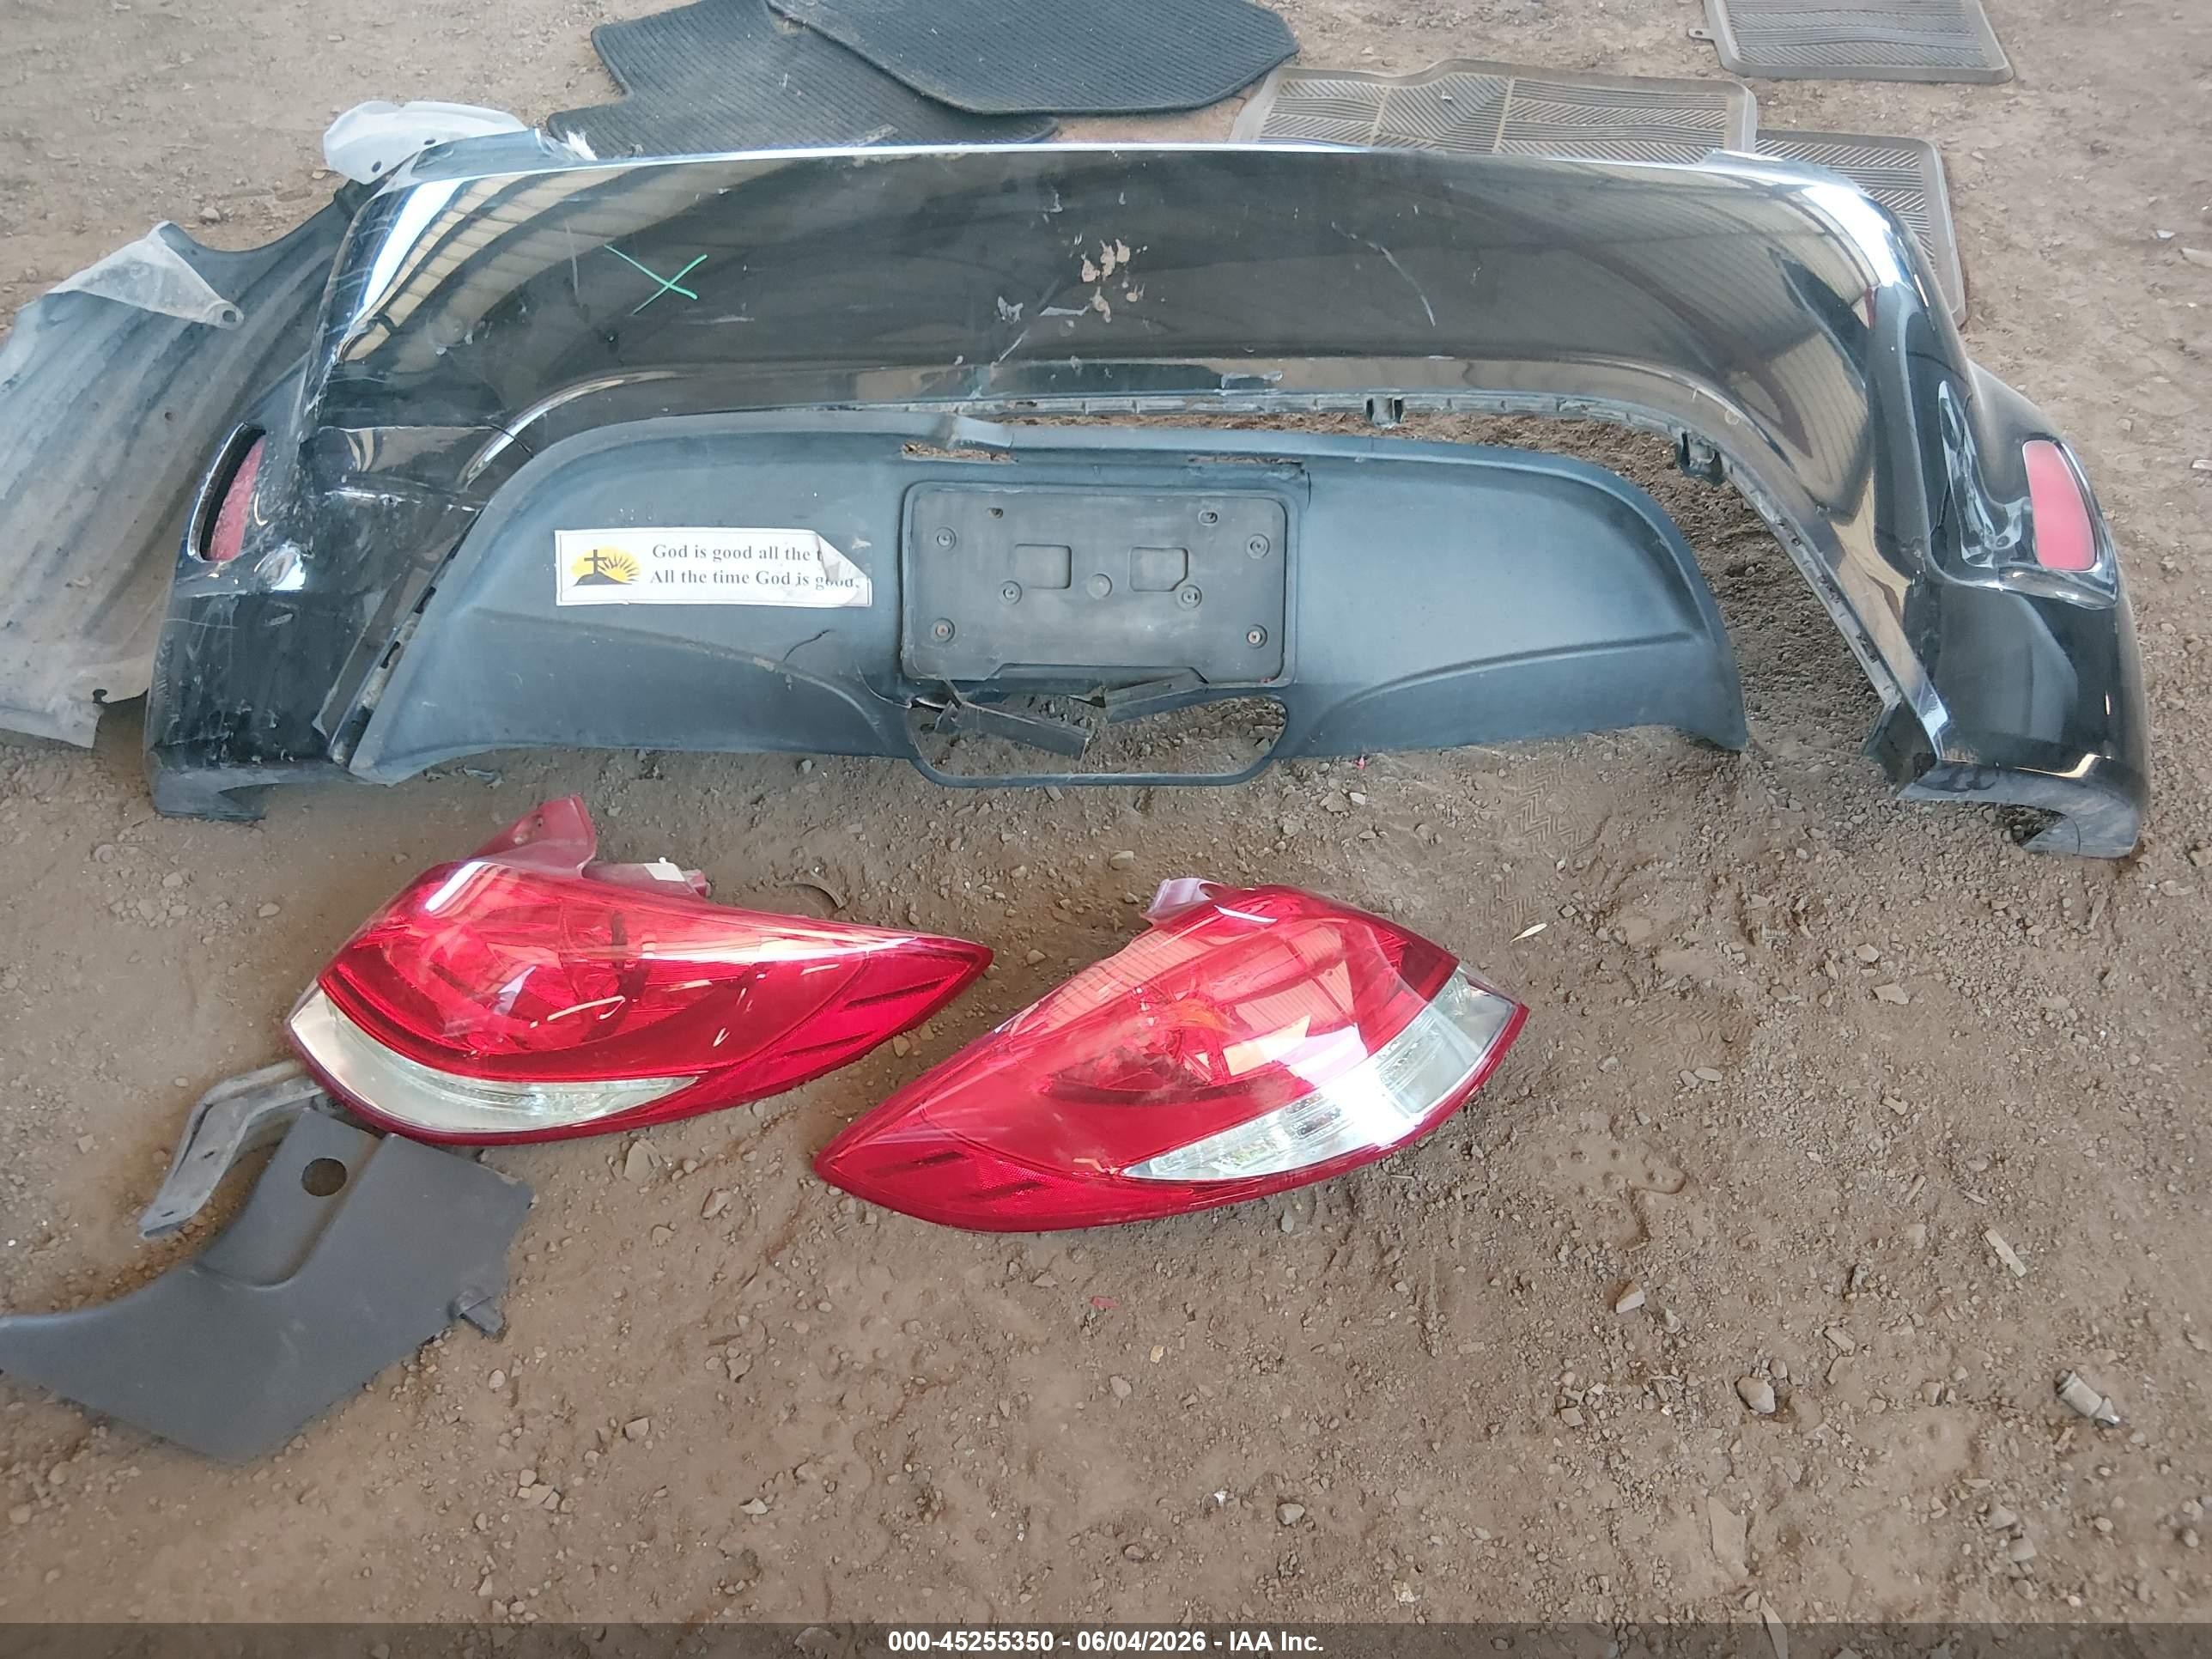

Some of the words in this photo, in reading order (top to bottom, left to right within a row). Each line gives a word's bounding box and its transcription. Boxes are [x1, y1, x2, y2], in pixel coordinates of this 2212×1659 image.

[653, 544, 688, 559] God
[695, 545, 707, 558] is
[713, 546, 752, 562] good
[759, 546, 779, 560] all
[785, 547, 811, 561] the
[650, 570, 675, 584] All
[681, 570, 707, 584] the
[713, 570, 749, 584] time
[756, 571, 790, 586] God
[796, 572, 810, 586] is
